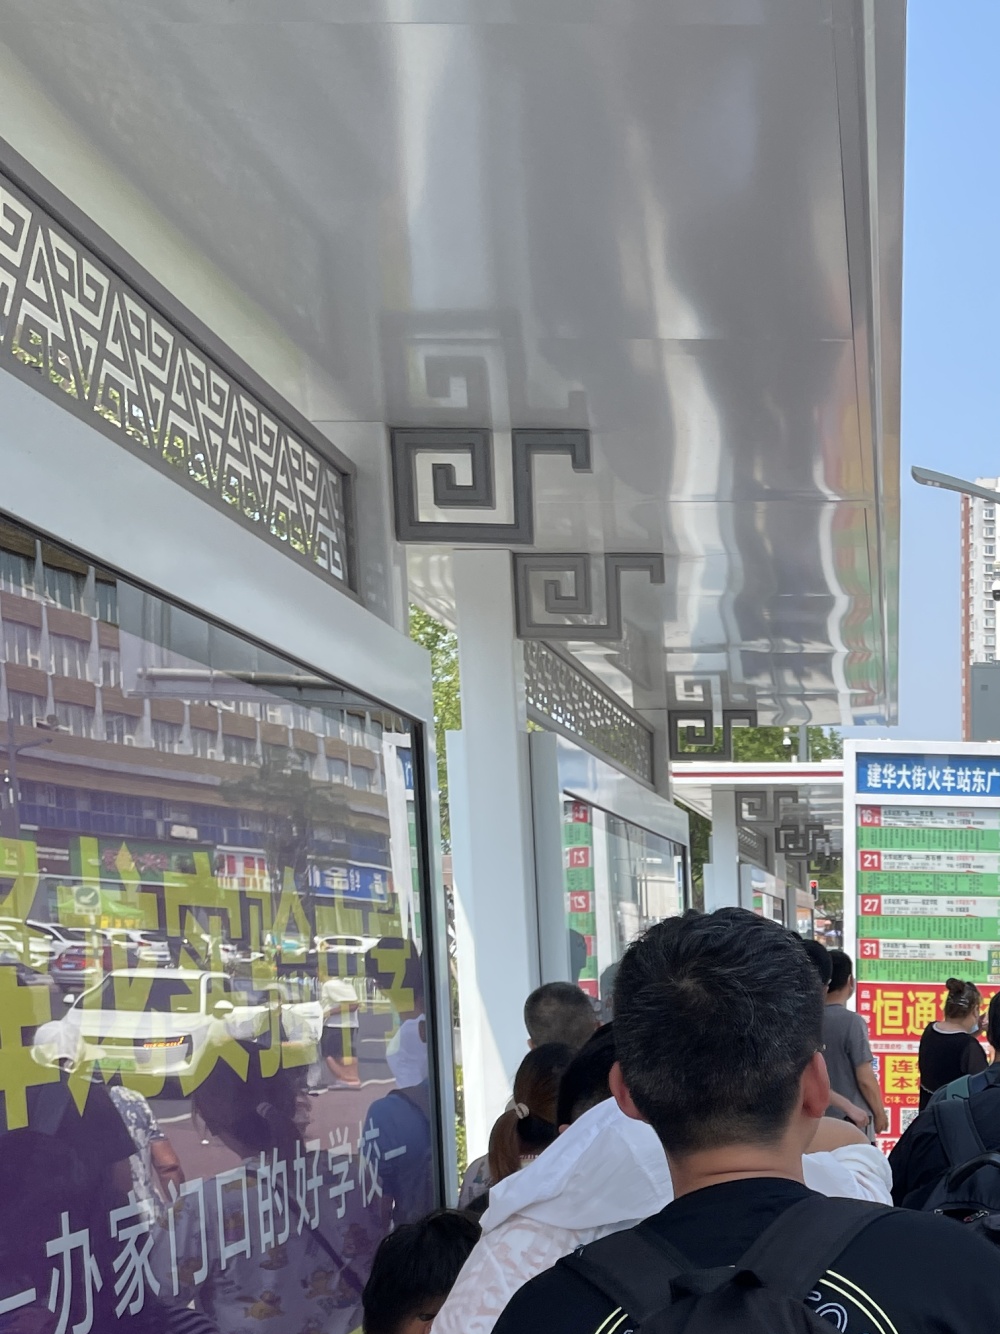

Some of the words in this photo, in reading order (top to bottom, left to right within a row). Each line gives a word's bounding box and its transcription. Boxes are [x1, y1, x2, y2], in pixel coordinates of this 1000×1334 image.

[863, 854, 879, 868] 21
[863, 898, 879, 913] 27
[862, 942, 878, 956] 31
[892, 1060, 920, 1073] 连
